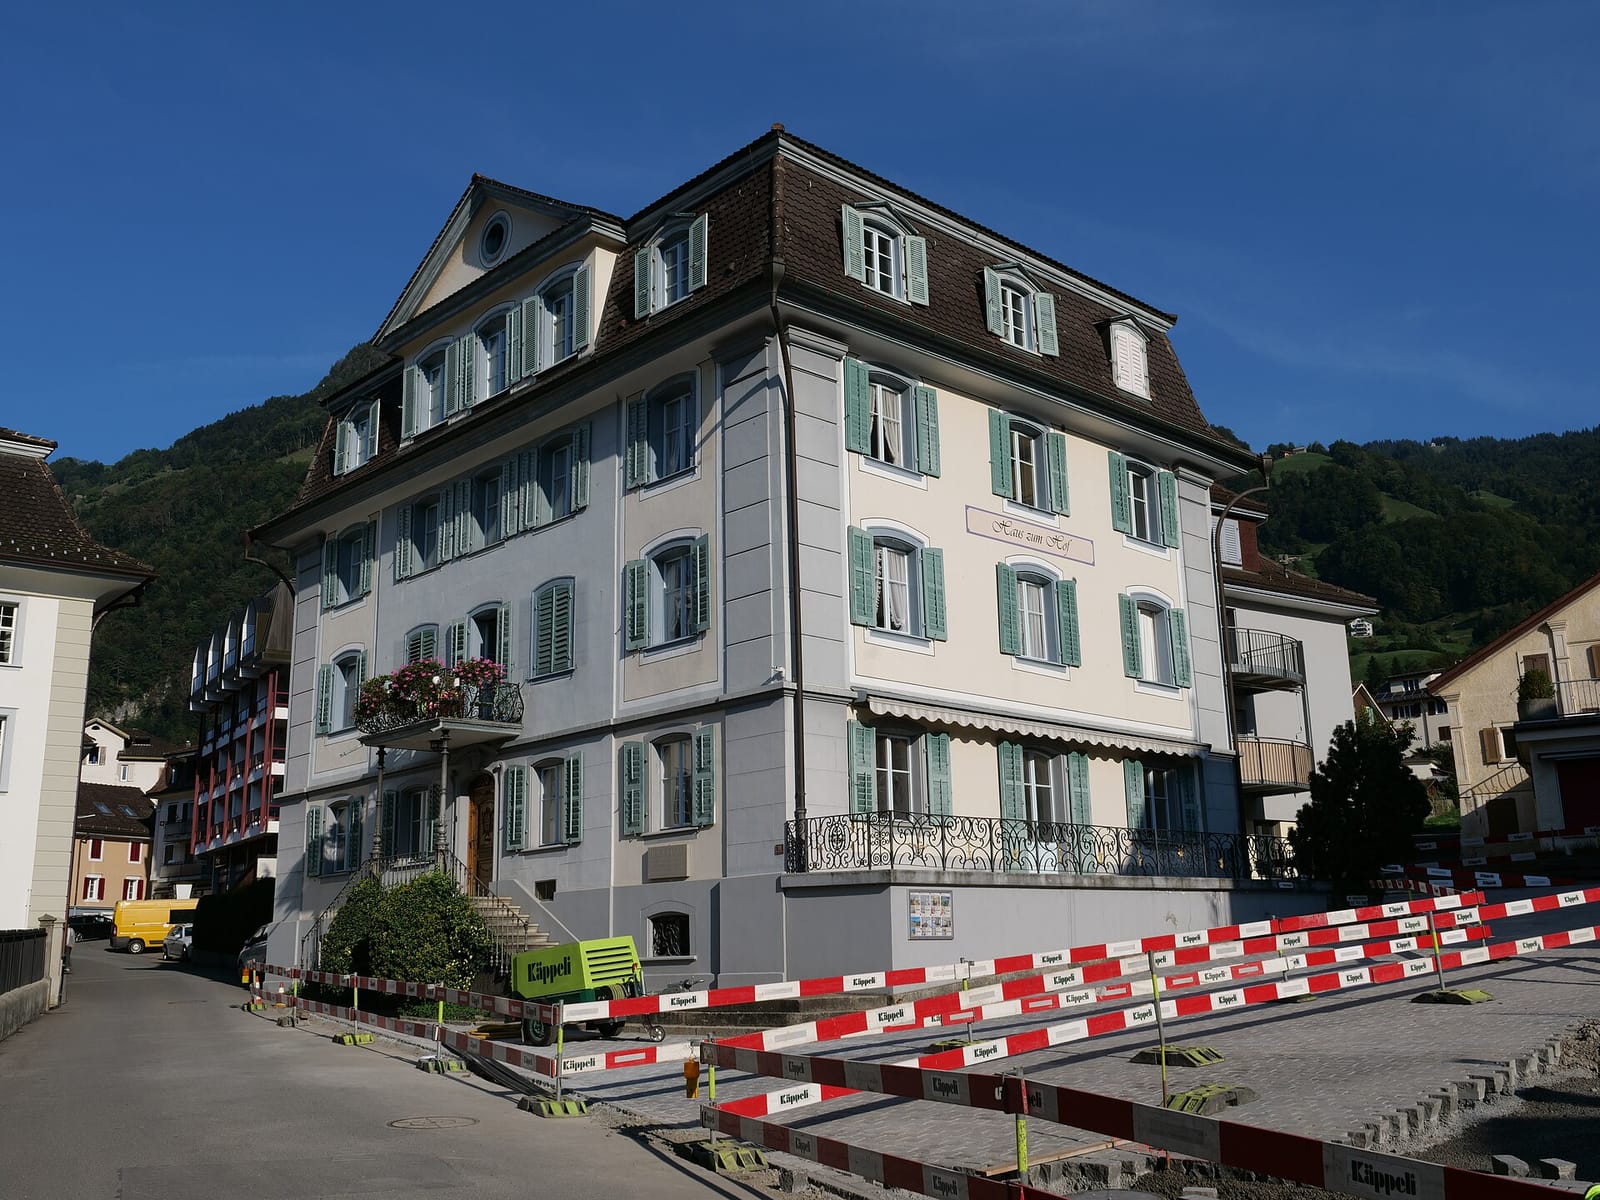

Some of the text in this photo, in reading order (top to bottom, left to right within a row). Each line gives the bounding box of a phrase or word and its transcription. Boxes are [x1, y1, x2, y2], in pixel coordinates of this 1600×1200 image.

[992, 520, 1073, 556] Haus zum Hof
[1041, 953, 1063, 965] Käppeli
[527, 956, 572, 985] Käppeli
[853, 977, 876, 988] Käppeli
[1053, 973, 1075, 985] Käppeli
[670, 995, 697, 1008] Käppeli
[1066, 992, 1089, 1004] Käppeli
[878, 1009, 904, 1023] Käppeli
[1132, 1008, 1153, 1022] Käppeli
[974, 1045, 998, 1058] Käppeli
[562, 1057, 596, 1072] Käppeli
[932, 1076, 959, 1097] Käppeli
[780, 1089, 809, 1105] Käppeli
[1351, 1159, 1417, 1196] Käppeli
[932, 1174, 958, 1196] Käppeli
